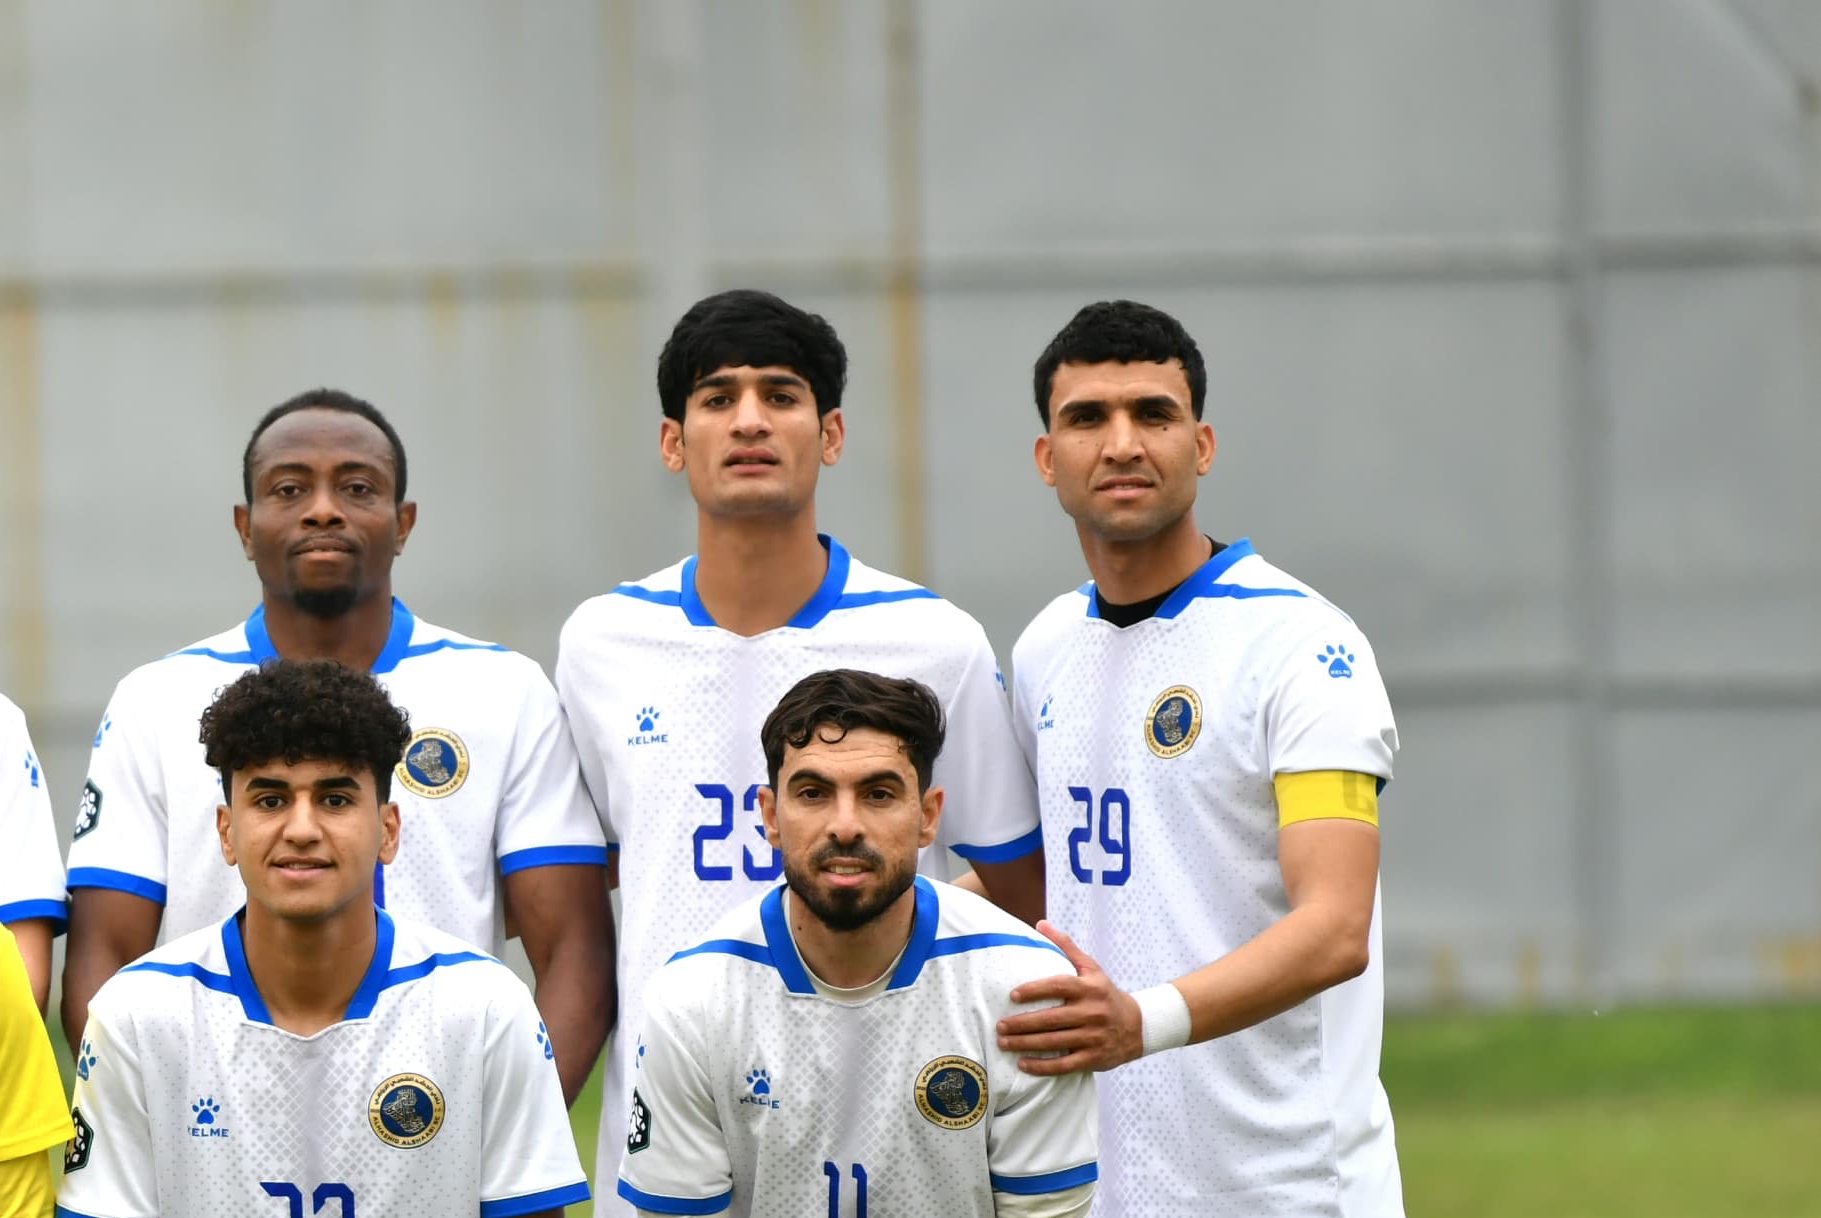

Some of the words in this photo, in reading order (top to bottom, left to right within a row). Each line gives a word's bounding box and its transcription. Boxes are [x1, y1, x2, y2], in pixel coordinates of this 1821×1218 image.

[627, 734, 668, 746] KELME
[692, 784, 784, 881] 23
[1068, 787, 1132, 886] 29
[739, 1096, 780, 1109] KELE
[187, 1126, 229, 1137] ELME
